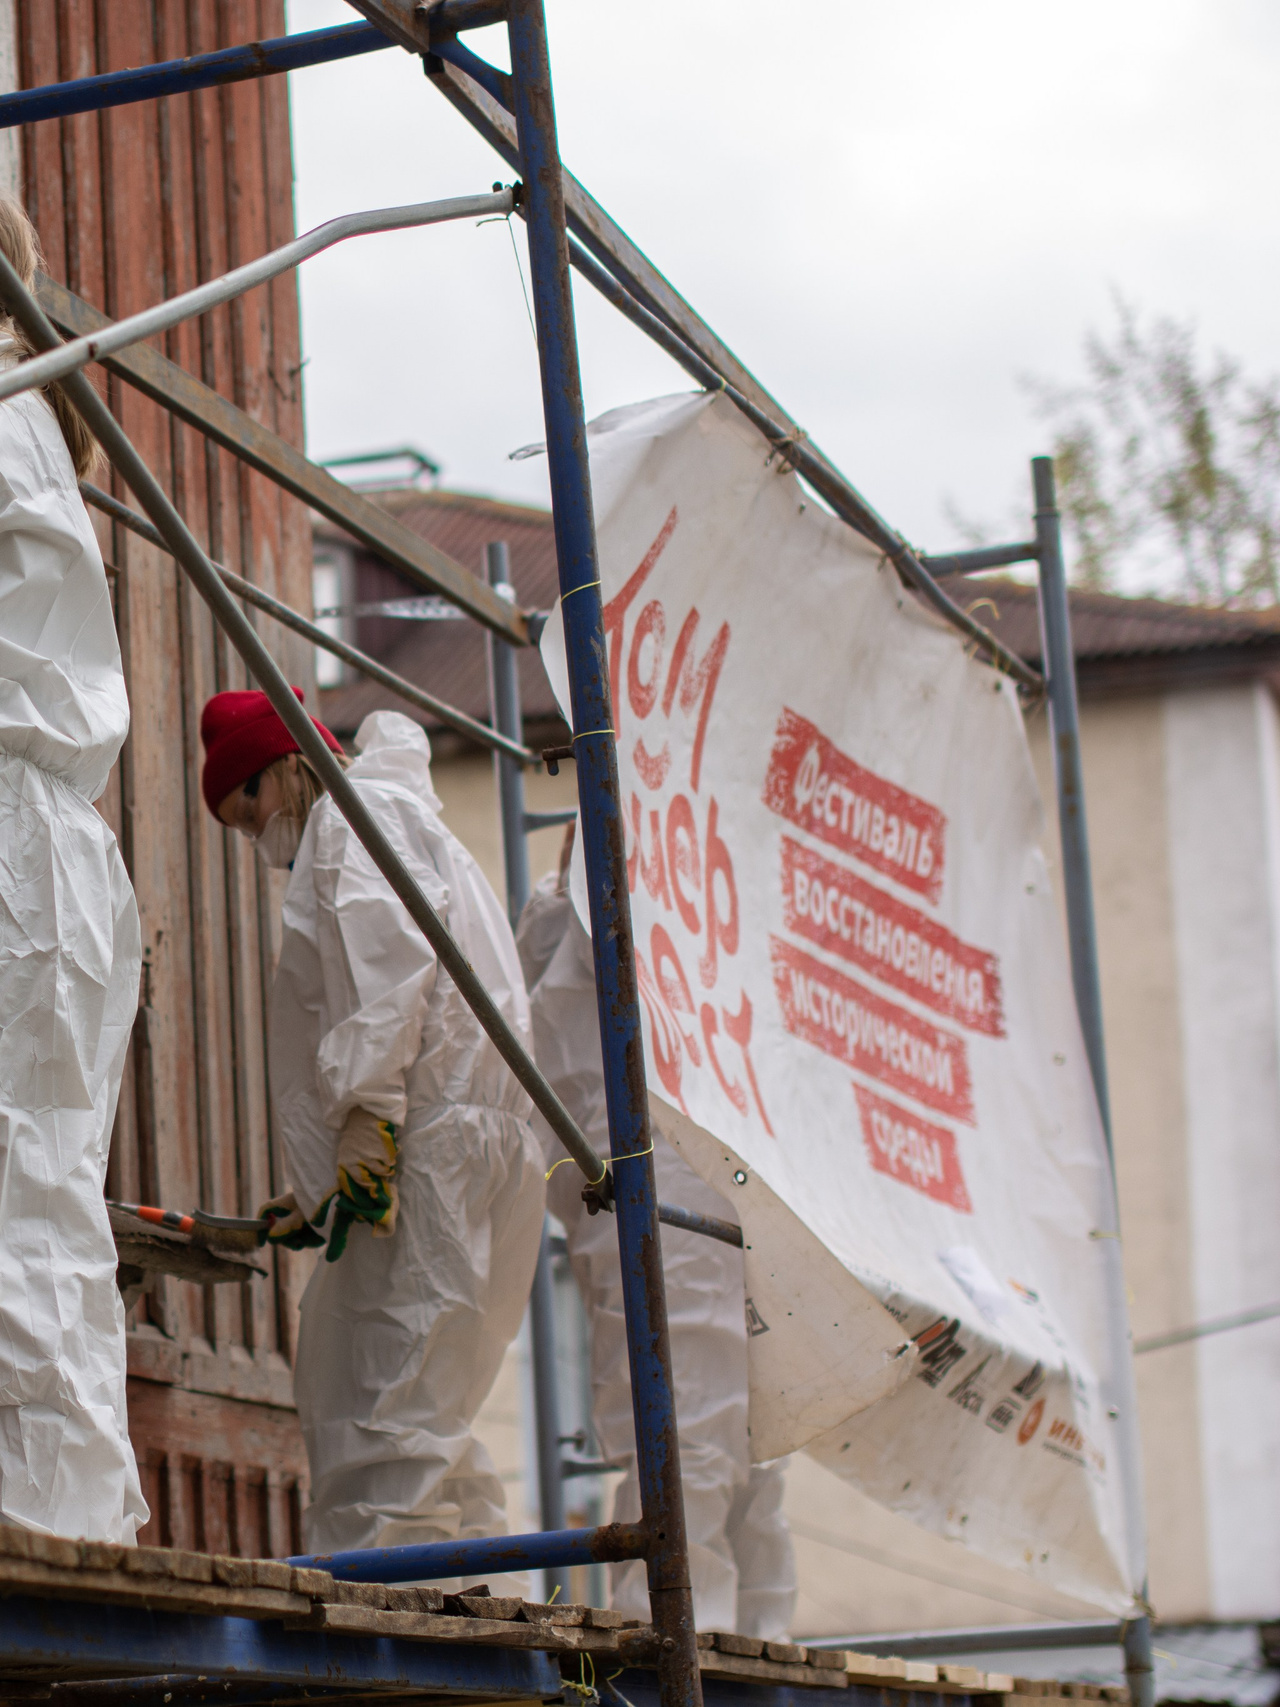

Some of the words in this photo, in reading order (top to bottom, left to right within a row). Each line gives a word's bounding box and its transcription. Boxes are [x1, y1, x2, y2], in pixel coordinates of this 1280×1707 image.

[793, 741, 934, 879] Фестиваль
[793, 868, 985, 1014] восстановления
[790, 968, 955, 1097] исторической
[870, 1109, 944, 1187] среды
